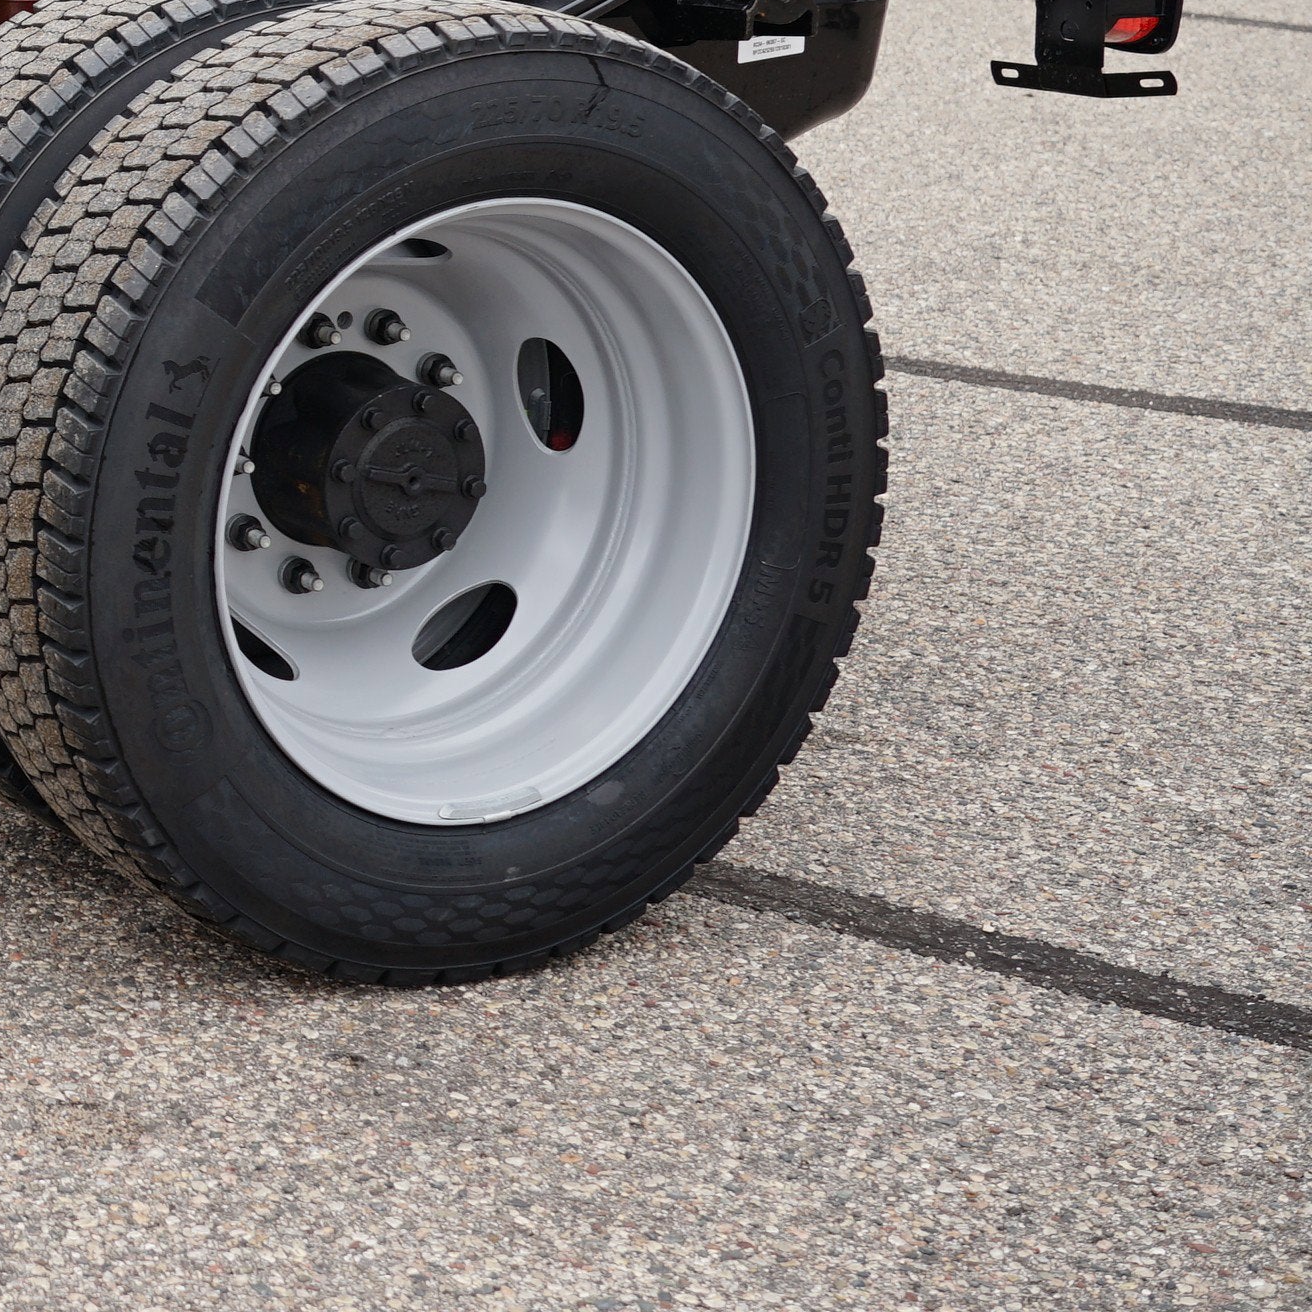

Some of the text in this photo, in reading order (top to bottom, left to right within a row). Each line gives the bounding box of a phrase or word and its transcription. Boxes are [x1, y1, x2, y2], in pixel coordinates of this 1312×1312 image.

[120, 401, 212, 770] Continental
[807, 348, 855, 606] Conti HDR 5
